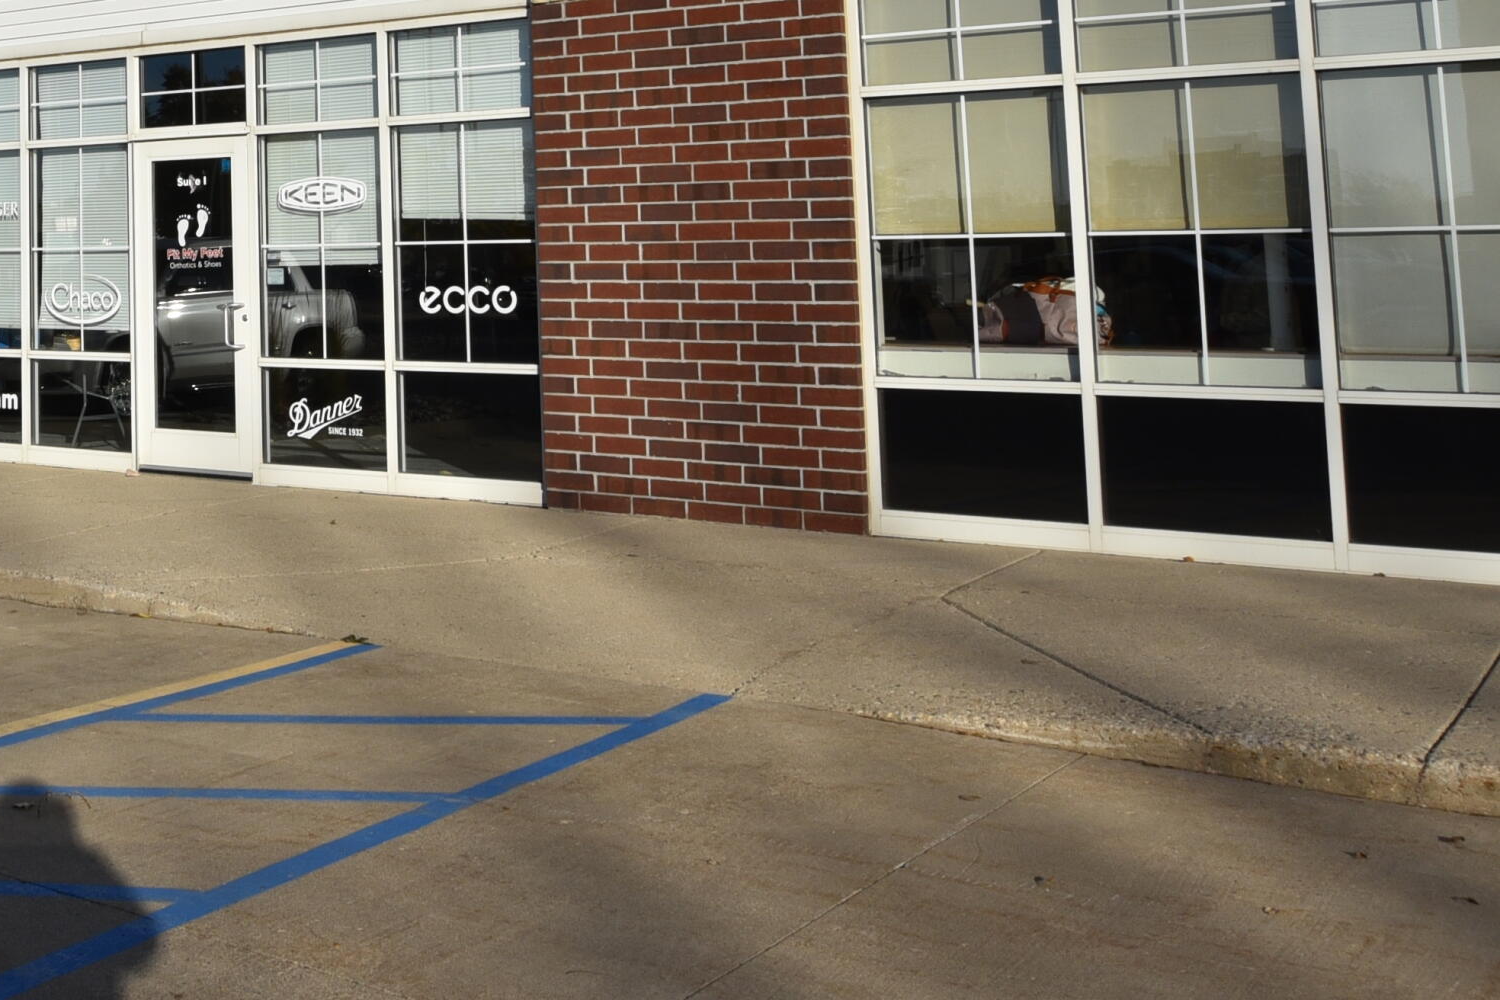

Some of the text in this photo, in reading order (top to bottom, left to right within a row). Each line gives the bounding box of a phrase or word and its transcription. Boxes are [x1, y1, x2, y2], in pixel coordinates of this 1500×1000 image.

[177, 176, 201, 187] Suie
[284, 182, 361, 205] KEEN
[182, 247, 198, 261] My
[169, 262, 197, 270] Orthotics
[51, 282, 115, 311] Chaco
[419, 285, 518, 315] ecco
[287, 394, 363, 438] Danner
[328, 426, 364, 437] SINCE 1932
